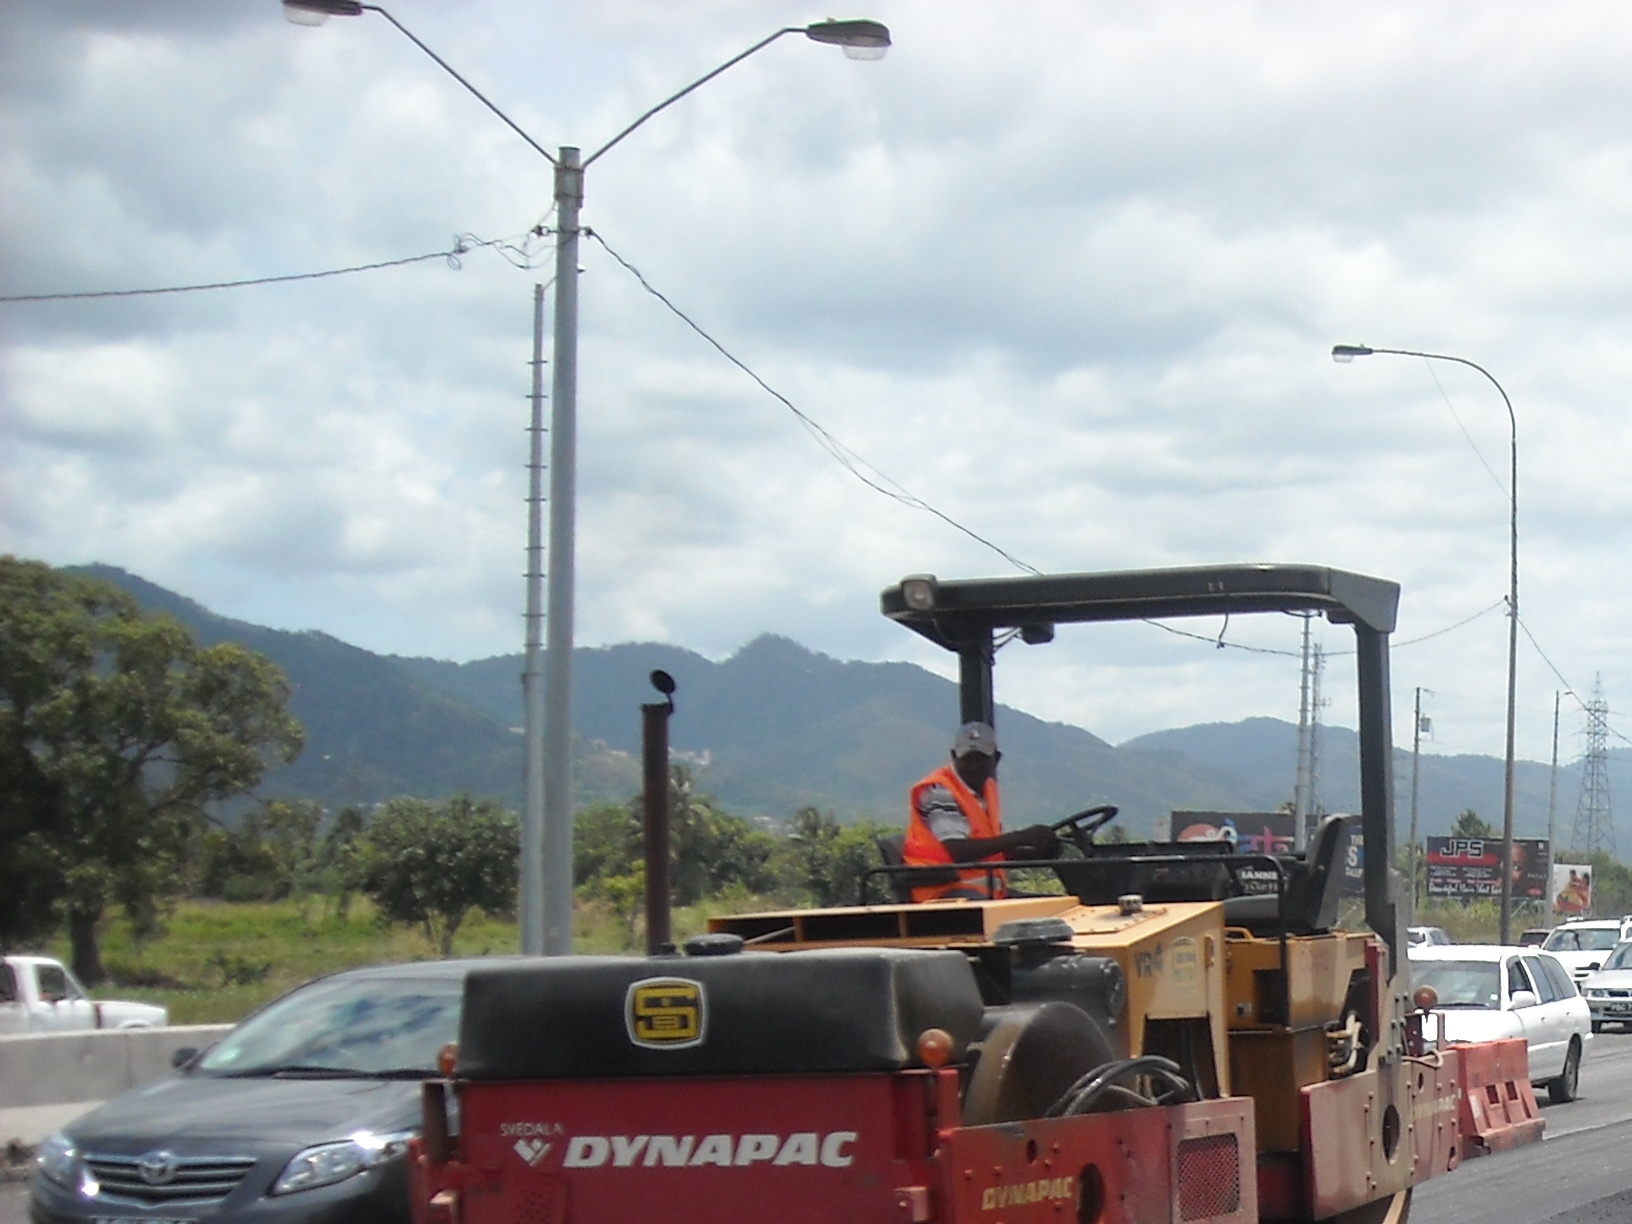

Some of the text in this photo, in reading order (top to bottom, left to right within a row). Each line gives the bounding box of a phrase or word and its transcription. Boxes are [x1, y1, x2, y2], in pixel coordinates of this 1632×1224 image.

[1440, 838, 1484, 858] JPS
[500, 1123, 563, 1136] SVEDALA
[562, 1132, 858, 1168] DYNAPAC
[981, 1176, 1074, 1211] DYNAPAC
